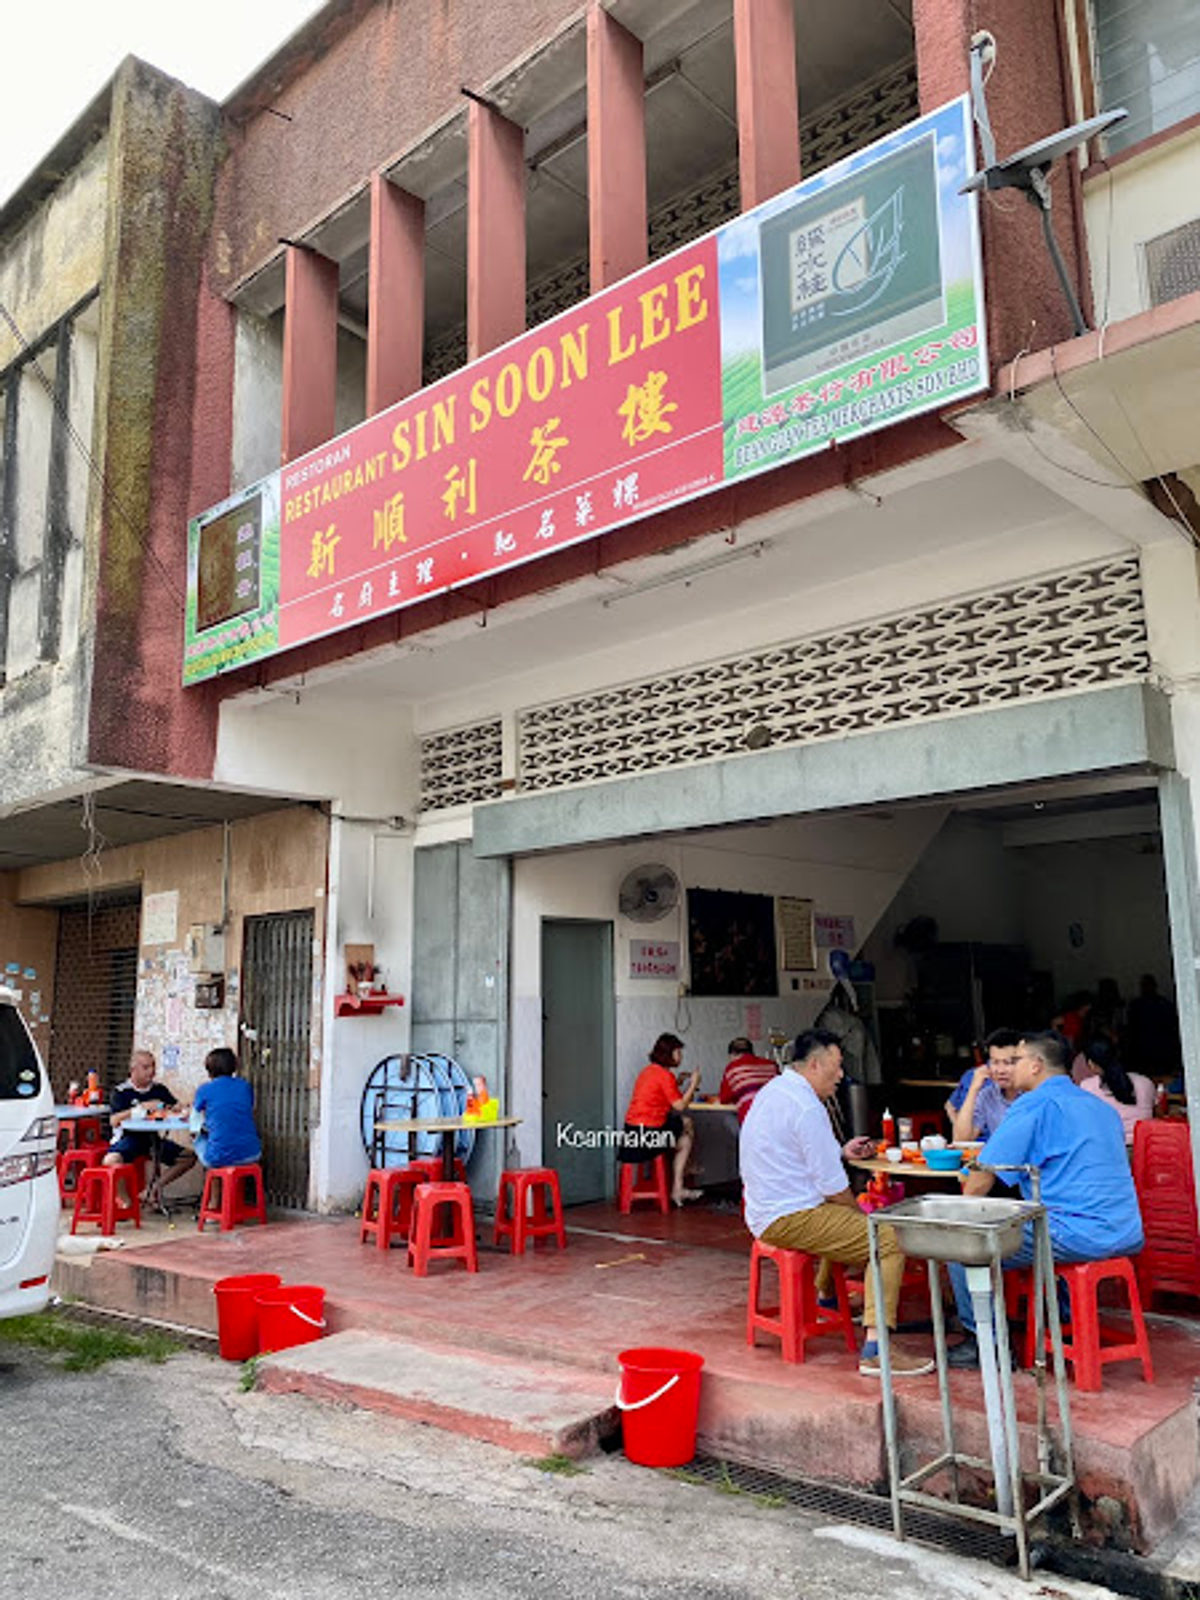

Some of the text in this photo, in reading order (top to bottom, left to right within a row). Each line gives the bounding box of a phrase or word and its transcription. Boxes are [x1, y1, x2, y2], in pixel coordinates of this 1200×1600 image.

[285, 452, 387, 524] RESTAURANT
[391, 394, 457, 472] SIN
[469, 323, 591, 434] SOON
[606, 264, 709, 366] LEE
[829, 381, 914, 431] MERCHANTS
[915, 371, 944, 398] SDN
[948, 358, 980, 387] BHD
[285, 445, 351, 490] RESTORAN
[306, 371, 679, 579] 新順利茶樓
